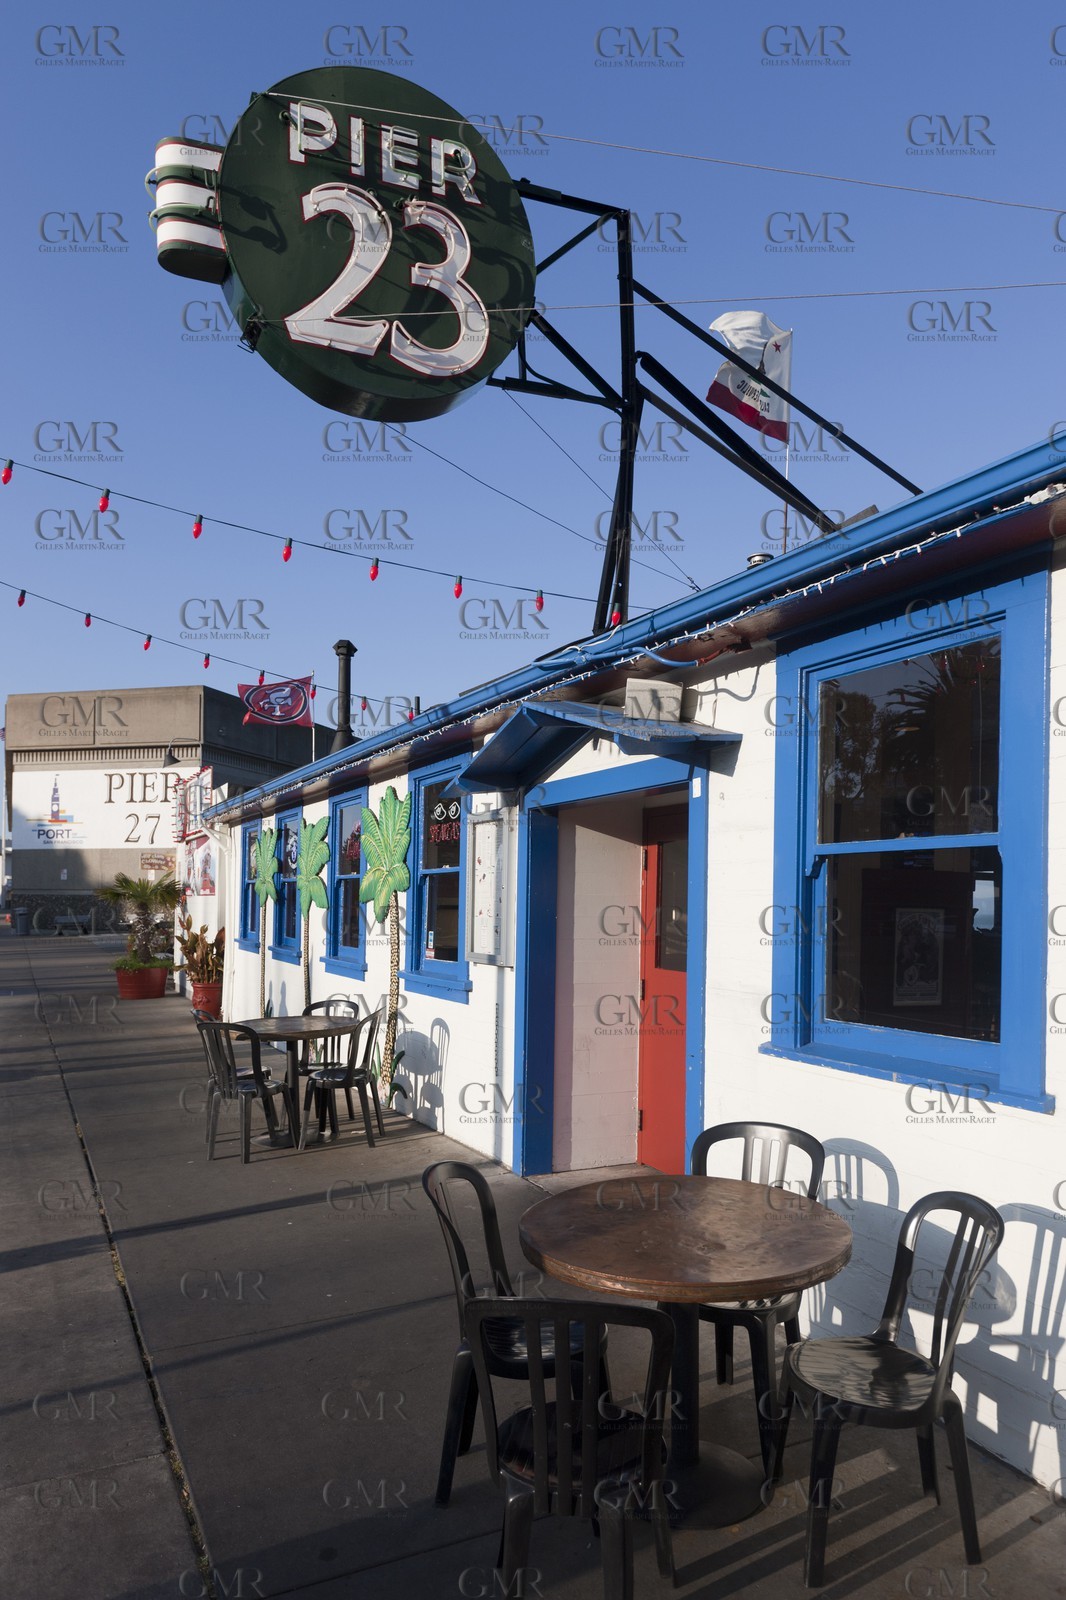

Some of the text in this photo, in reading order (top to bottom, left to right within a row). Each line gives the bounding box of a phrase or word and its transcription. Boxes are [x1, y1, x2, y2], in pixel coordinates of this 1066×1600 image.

[288, 101, 482, 205] PIER
[284, 182, 490, 377] 23
[104, 772, 179, 804] PIER
[38, 828, 72, 840] PORT
[124, 813, 160, 845] 27
